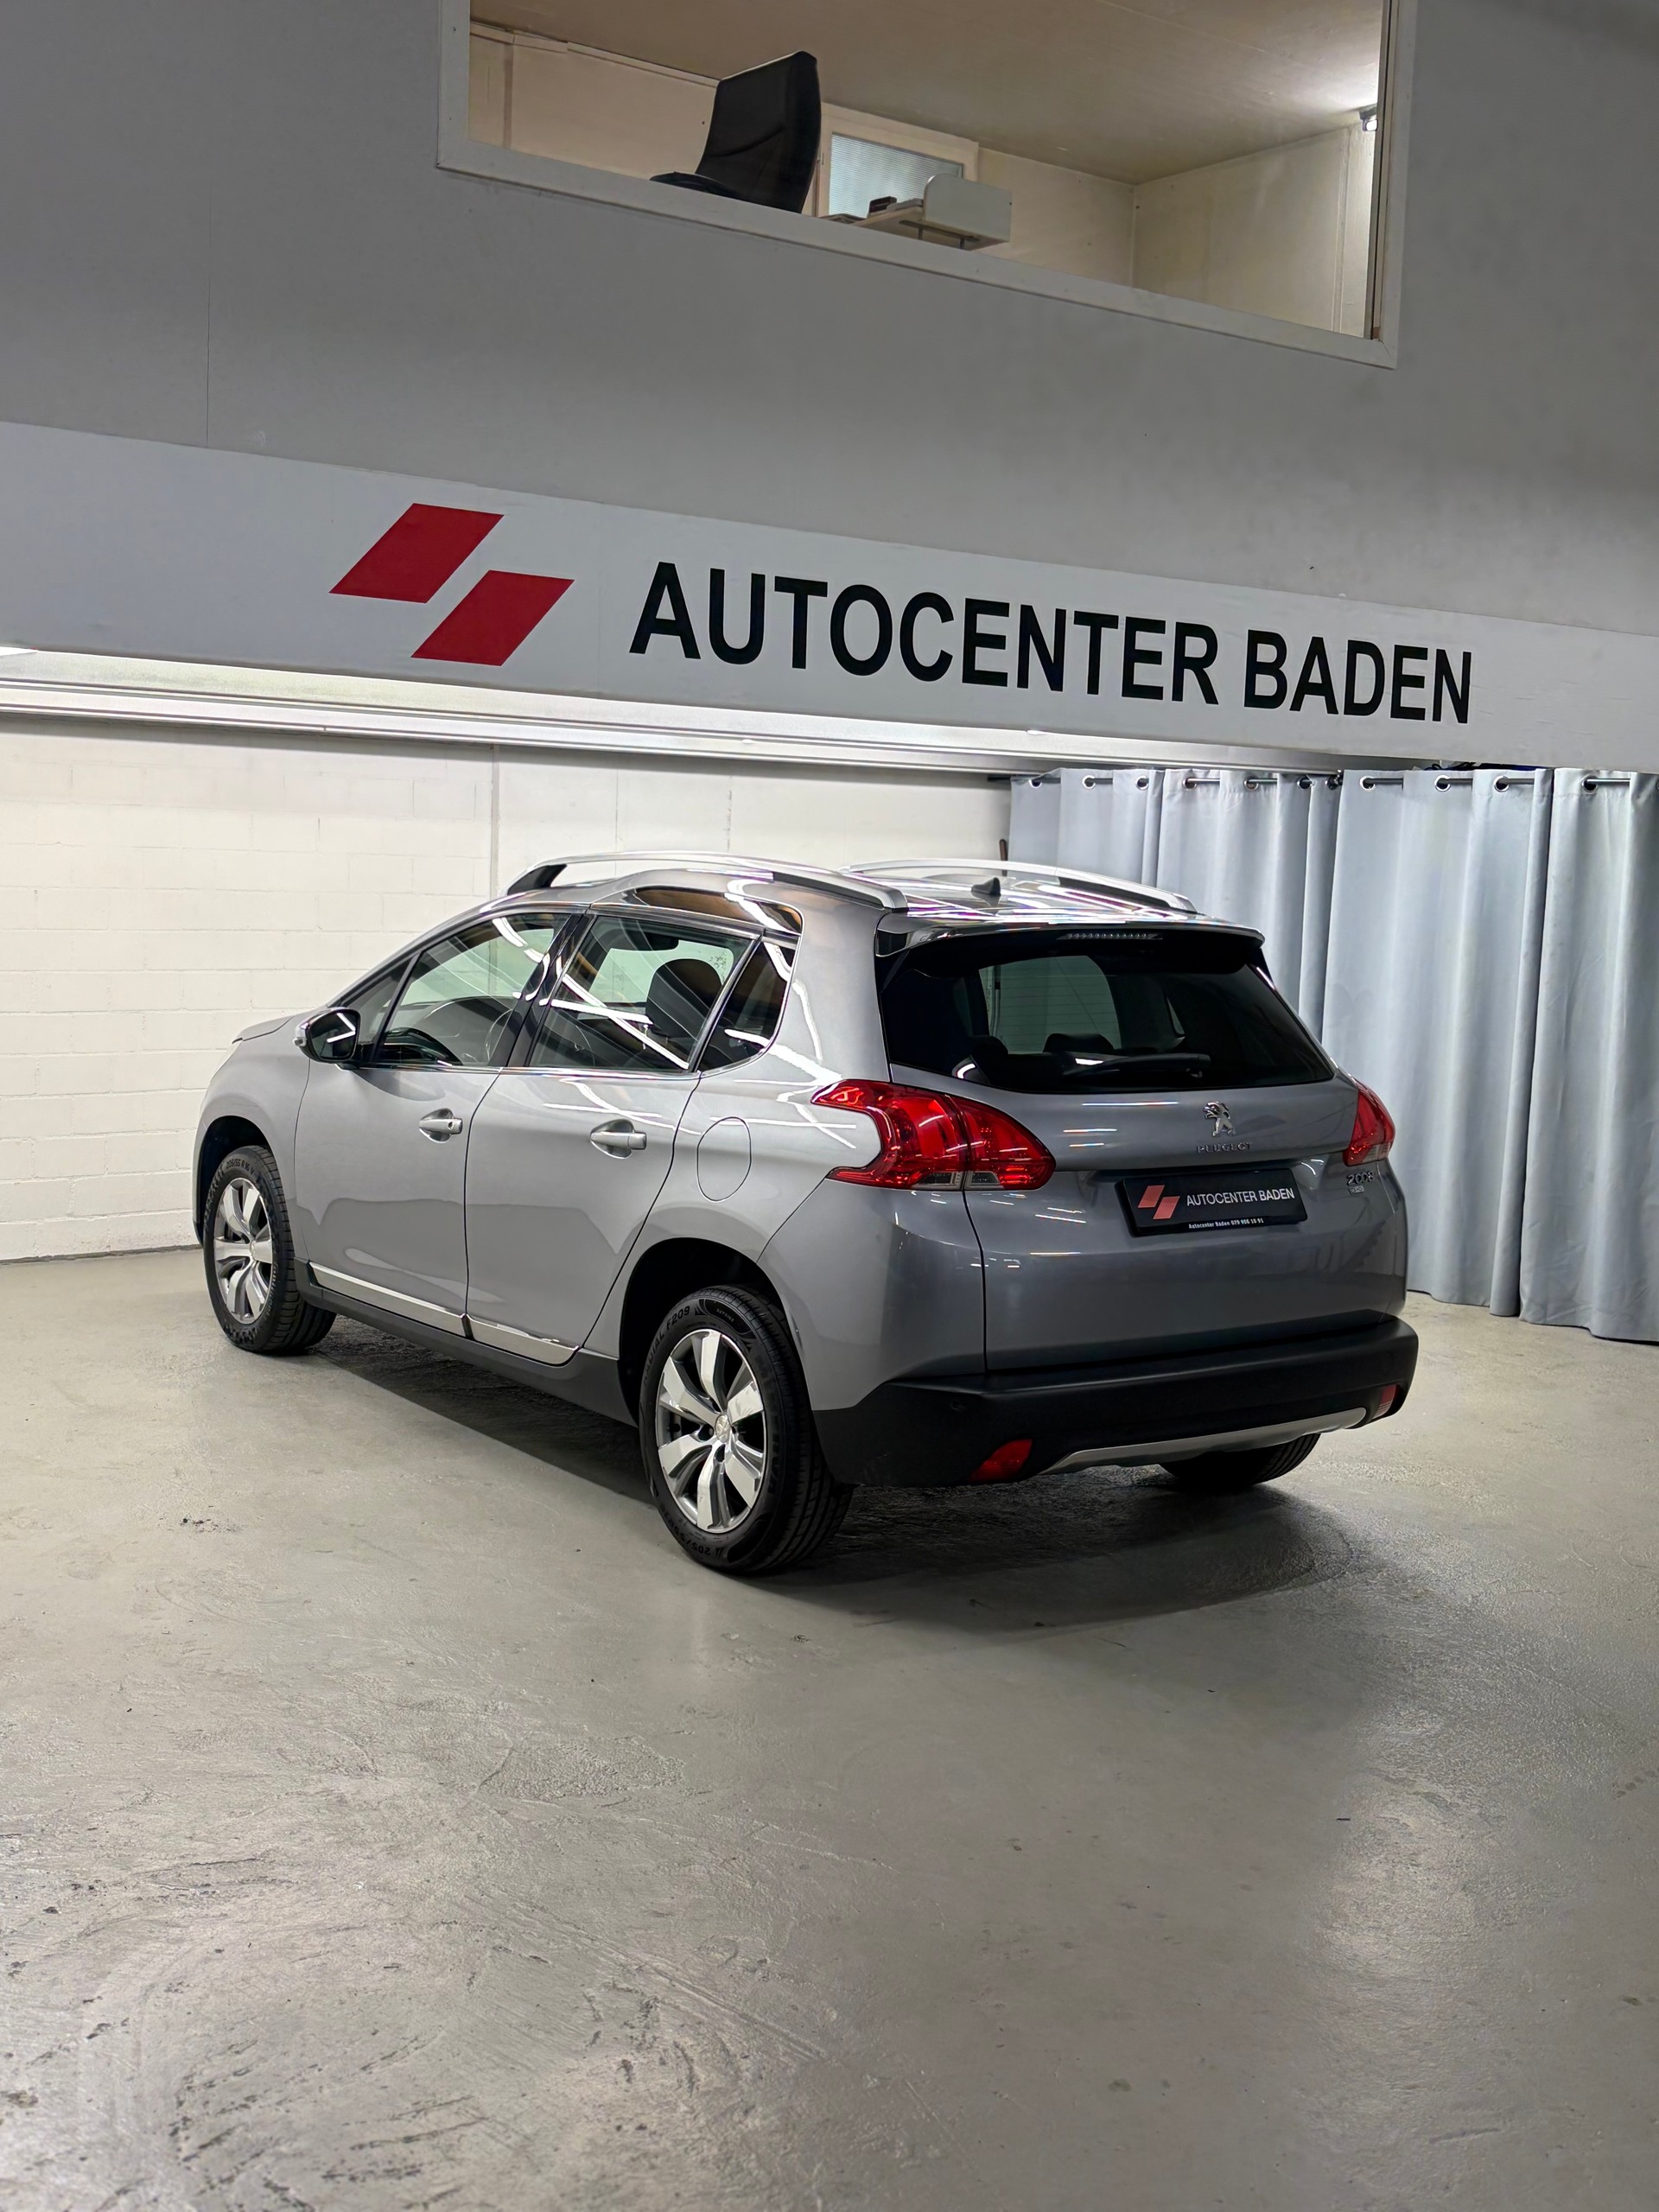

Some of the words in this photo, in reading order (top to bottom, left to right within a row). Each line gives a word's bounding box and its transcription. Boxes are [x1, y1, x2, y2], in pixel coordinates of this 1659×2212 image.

[629, 562, 1218, 704] AUTOCENTER
[1244, 630, 1471, 723] BADEN
[1197, 1141, 1252, 1153] PEUGEOT
[1346, 1170, 1374, 1185] 2008
[1185, 1190, 1258, 1207] AUTOCENTER
[1259, 1187, 1295, 1201] BADEN
